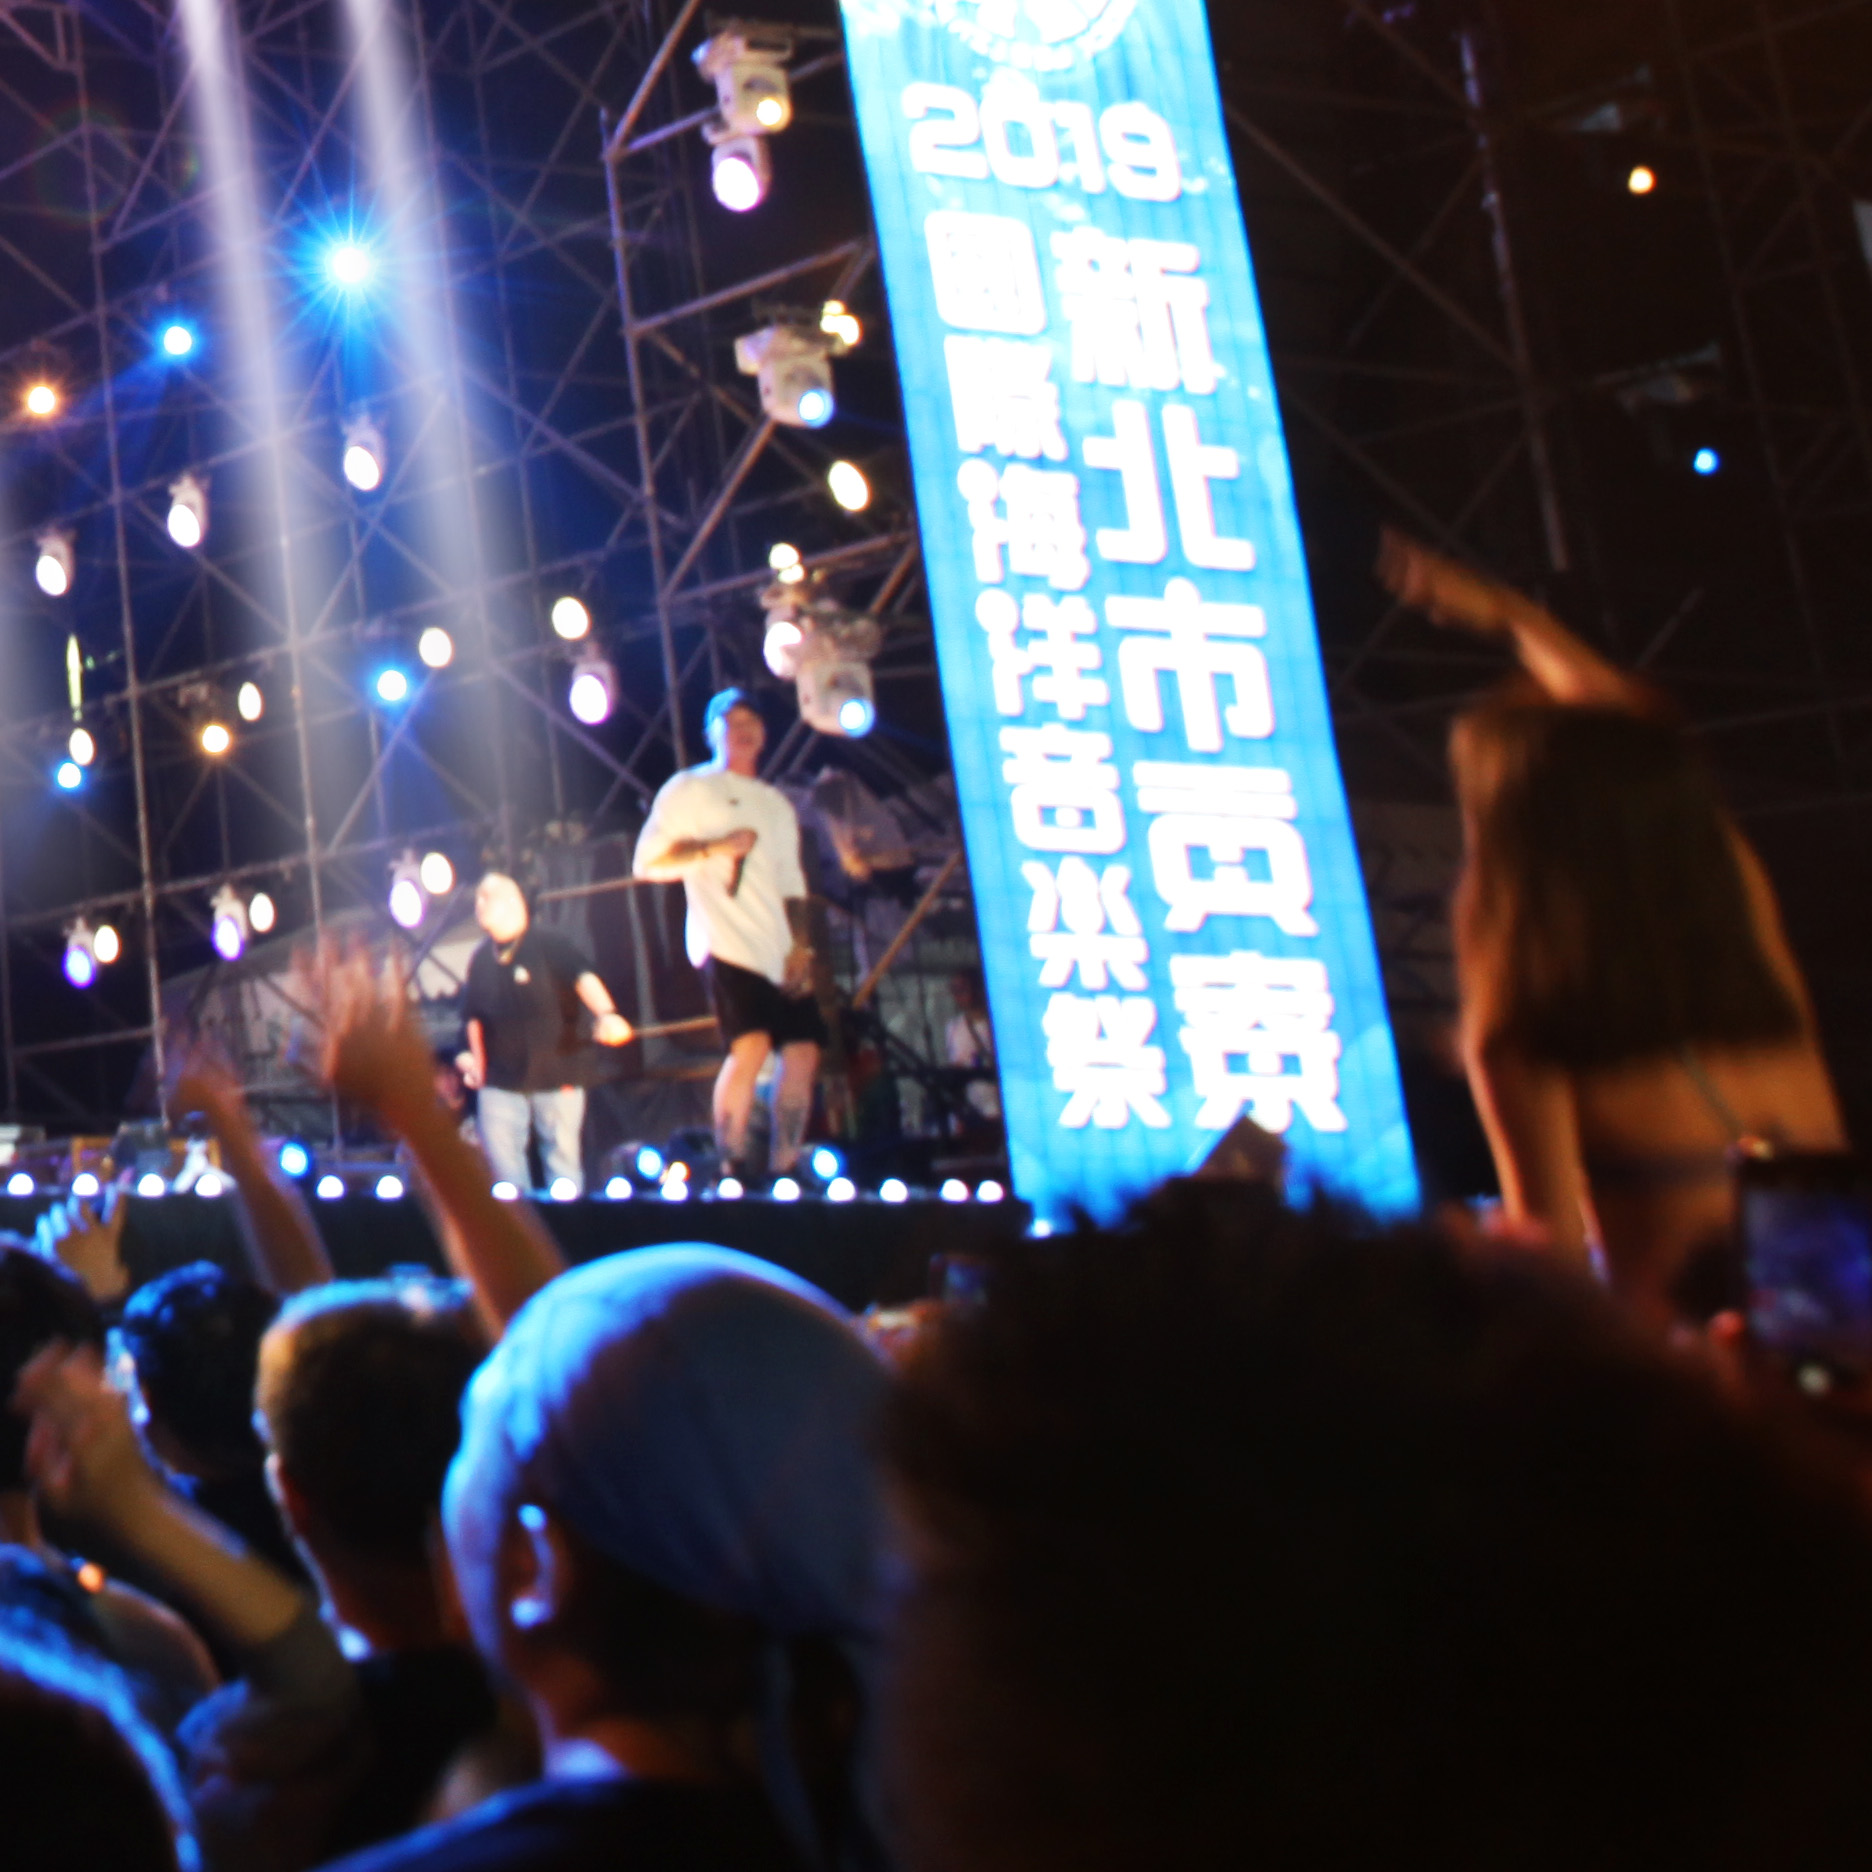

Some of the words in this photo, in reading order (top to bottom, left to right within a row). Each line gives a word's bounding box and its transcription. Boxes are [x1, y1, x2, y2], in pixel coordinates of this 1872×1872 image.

[901, 80, 1182, 202] 2019
[1049, 224, 1348, 1133] 新北市貢寮
